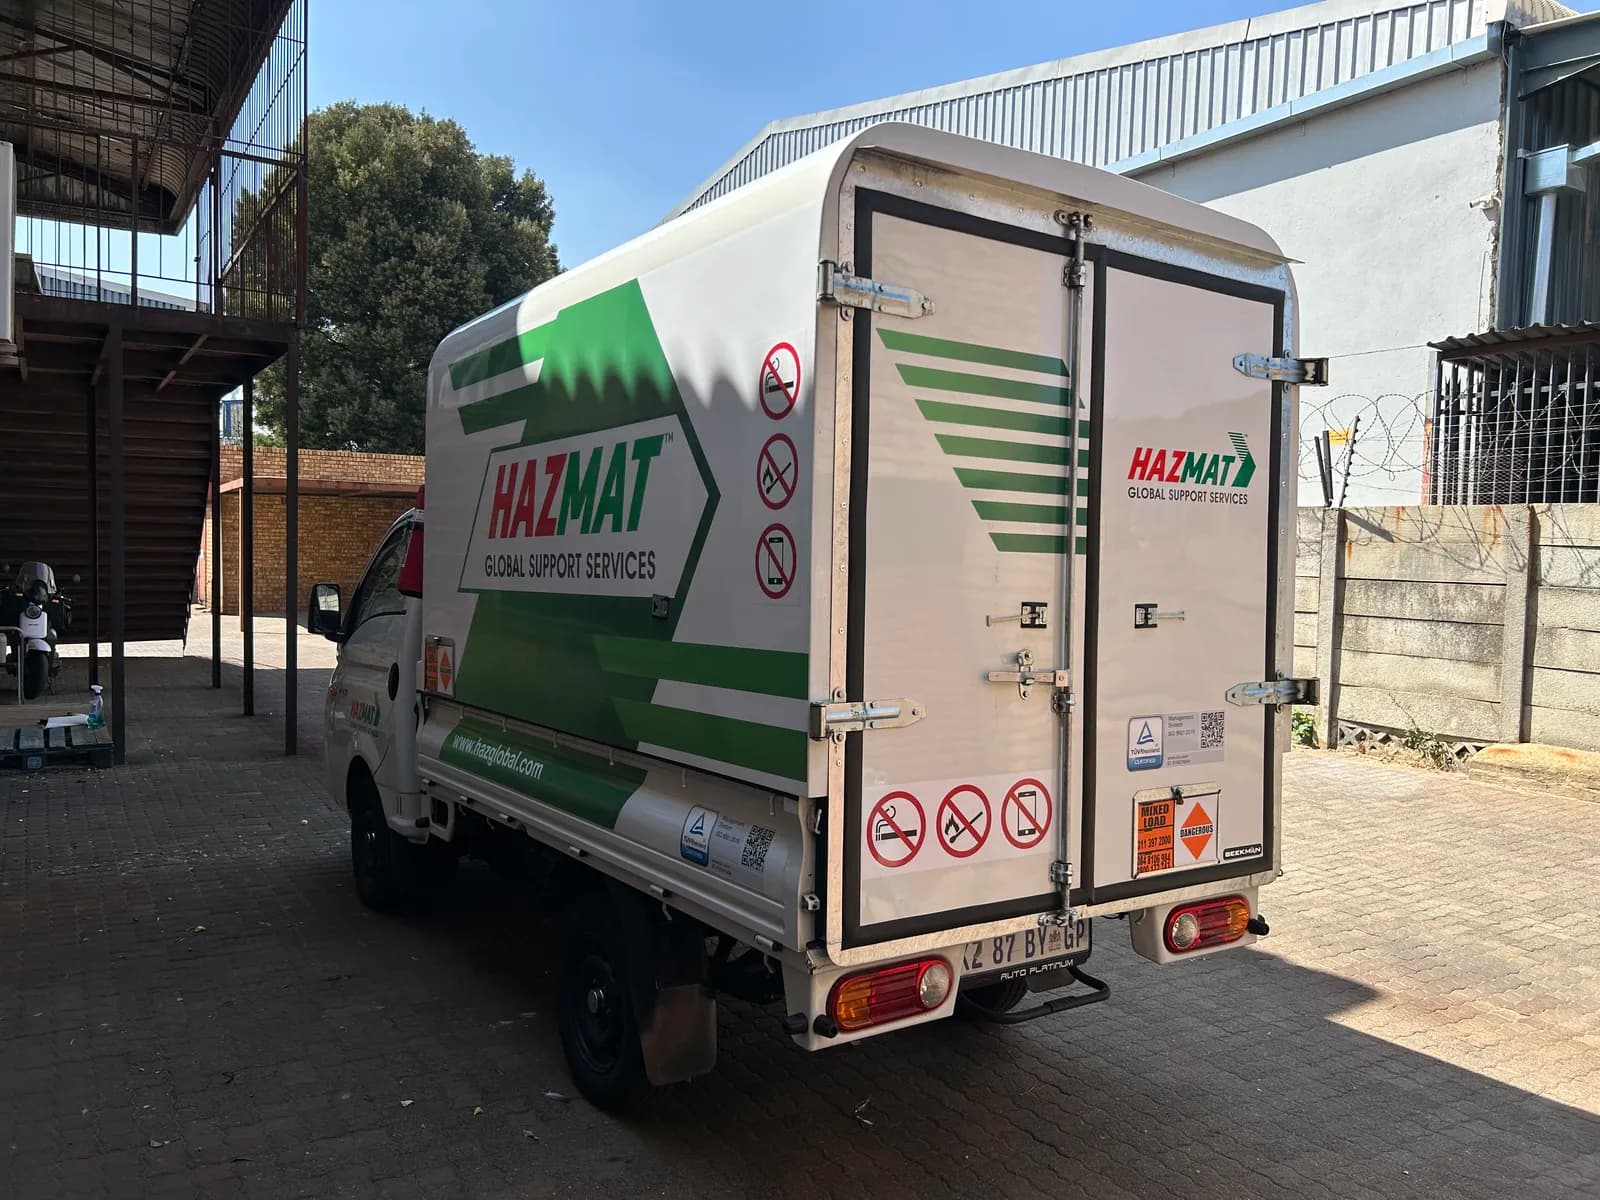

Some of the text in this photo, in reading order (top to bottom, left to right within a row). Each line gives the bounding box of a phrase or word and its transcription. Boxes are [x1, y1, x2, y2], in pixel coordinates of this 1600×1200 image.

[1128, 447, 1236, 486] HAZMAT
[488, 434, 664, 539] HAZMAT
[1128, 487, 1248, 505] GLOBAL SUPPORT SERVICES
[485, 550, 656, 580] GLOBAL SUPPORT SERVICES
[453, 734, 544, 780] www.hazglobal.com
[1141, 803, 1169, 817] MIXED
[1143, 815, 1166, 828] LOAD
[1180, 824, 1214, 838] DANGEROUS
[1225, 846, 1261, 858] BEEKMAN
[992, 934, 1016, 965] 87
[1025, 925, 1047, 959] BY
[1064, 919, 1085, 950] GP
[1000, 959, 1074, 981] AUTO PLATINUM
